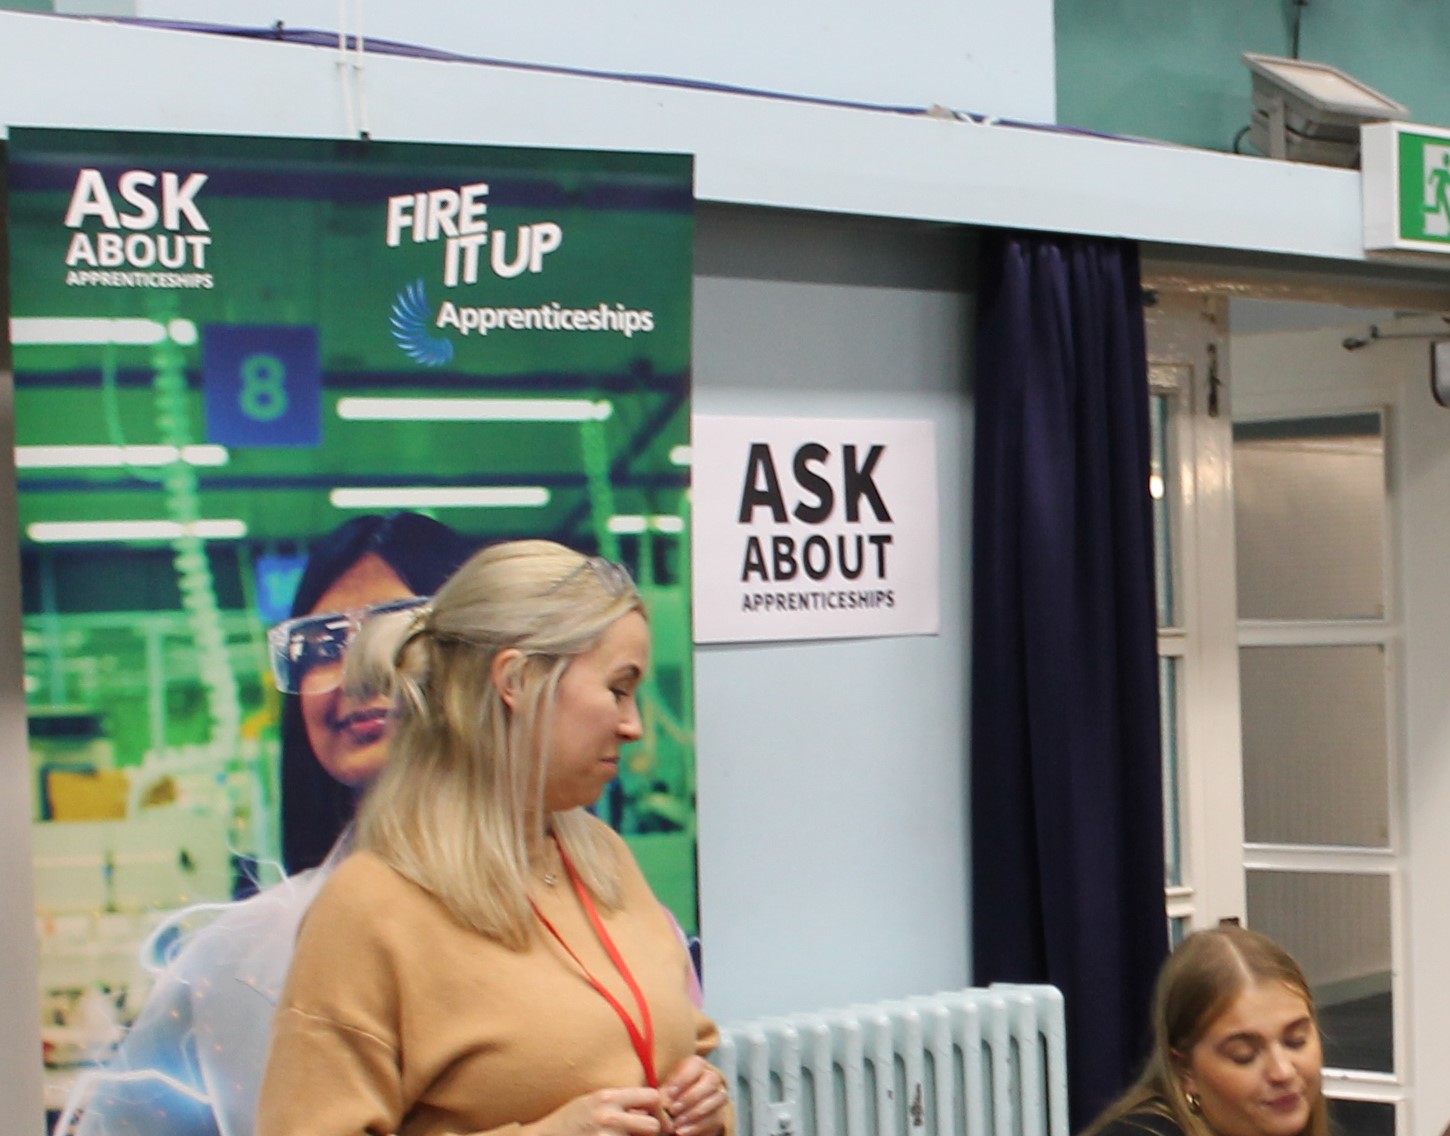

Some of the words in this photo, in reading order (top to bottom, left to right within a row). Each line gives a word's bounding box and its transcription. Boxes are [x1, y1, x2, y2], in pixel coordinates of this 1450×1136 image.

[64, 168, 210, 231] ASK
[386, 182, 489, 247] FIRE
[65, 232, 211, 269] ABOUT
[444, 233, 487, 287] IT
[490, 221, 563, 278] UP
[65, 270, 214, 289] APPRENTICESHIPS
[436, 300, 655, 338] Apprenticeships
[239, 354, 288, 422] 8
[738, 442, 893, 524] ASK
[741, 534, 893, 581] ABOUT
[741, 590, 896, 612] APPRENTICESHIPS
